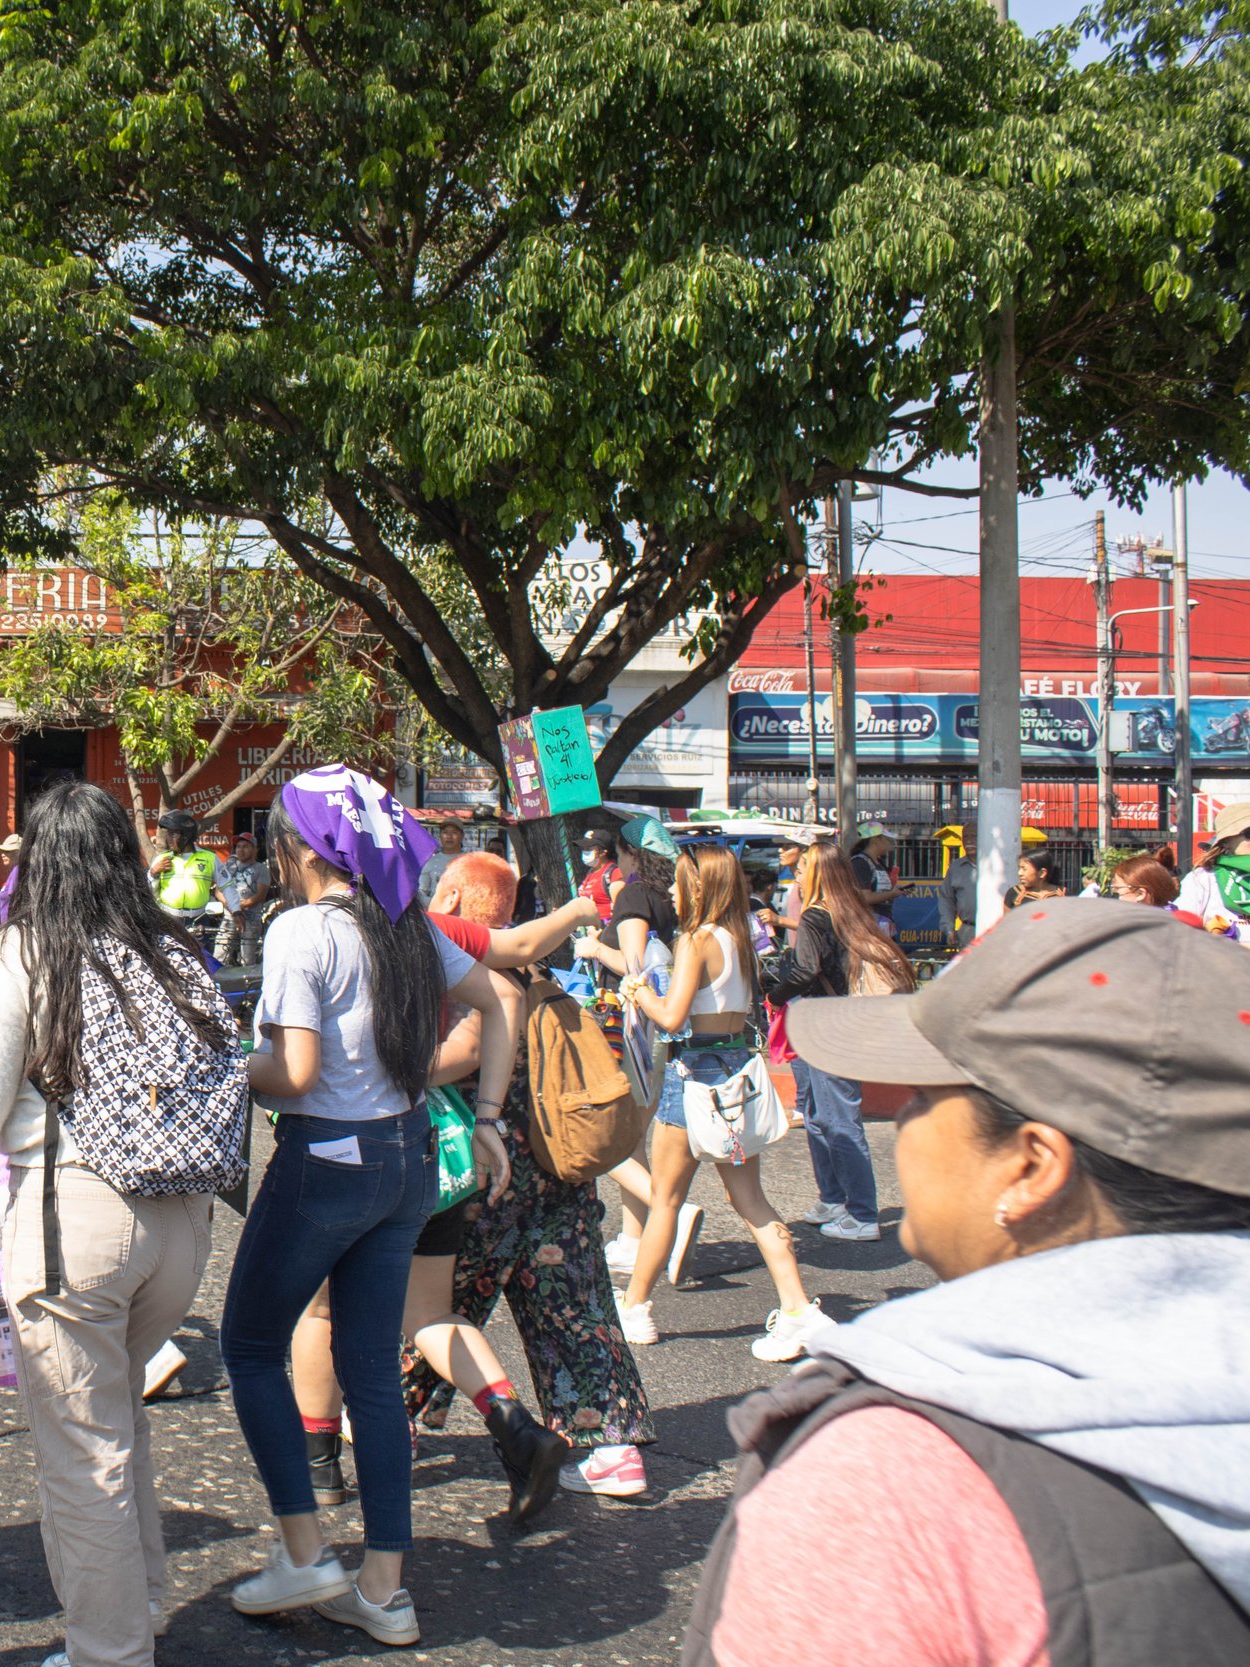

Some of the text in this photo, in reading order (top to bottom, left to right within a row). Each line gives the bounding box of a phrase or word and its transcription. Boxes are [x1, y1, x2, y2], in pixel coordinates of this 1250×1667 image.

[1020, 676, 1054, 696] FÉ
[541, 725, 570, 740] Nos
[1035, 729, 1089, 747] MOTO!
[183, 784, 223, 805] UTILES
[769, 806, 838, 823] DINRO
